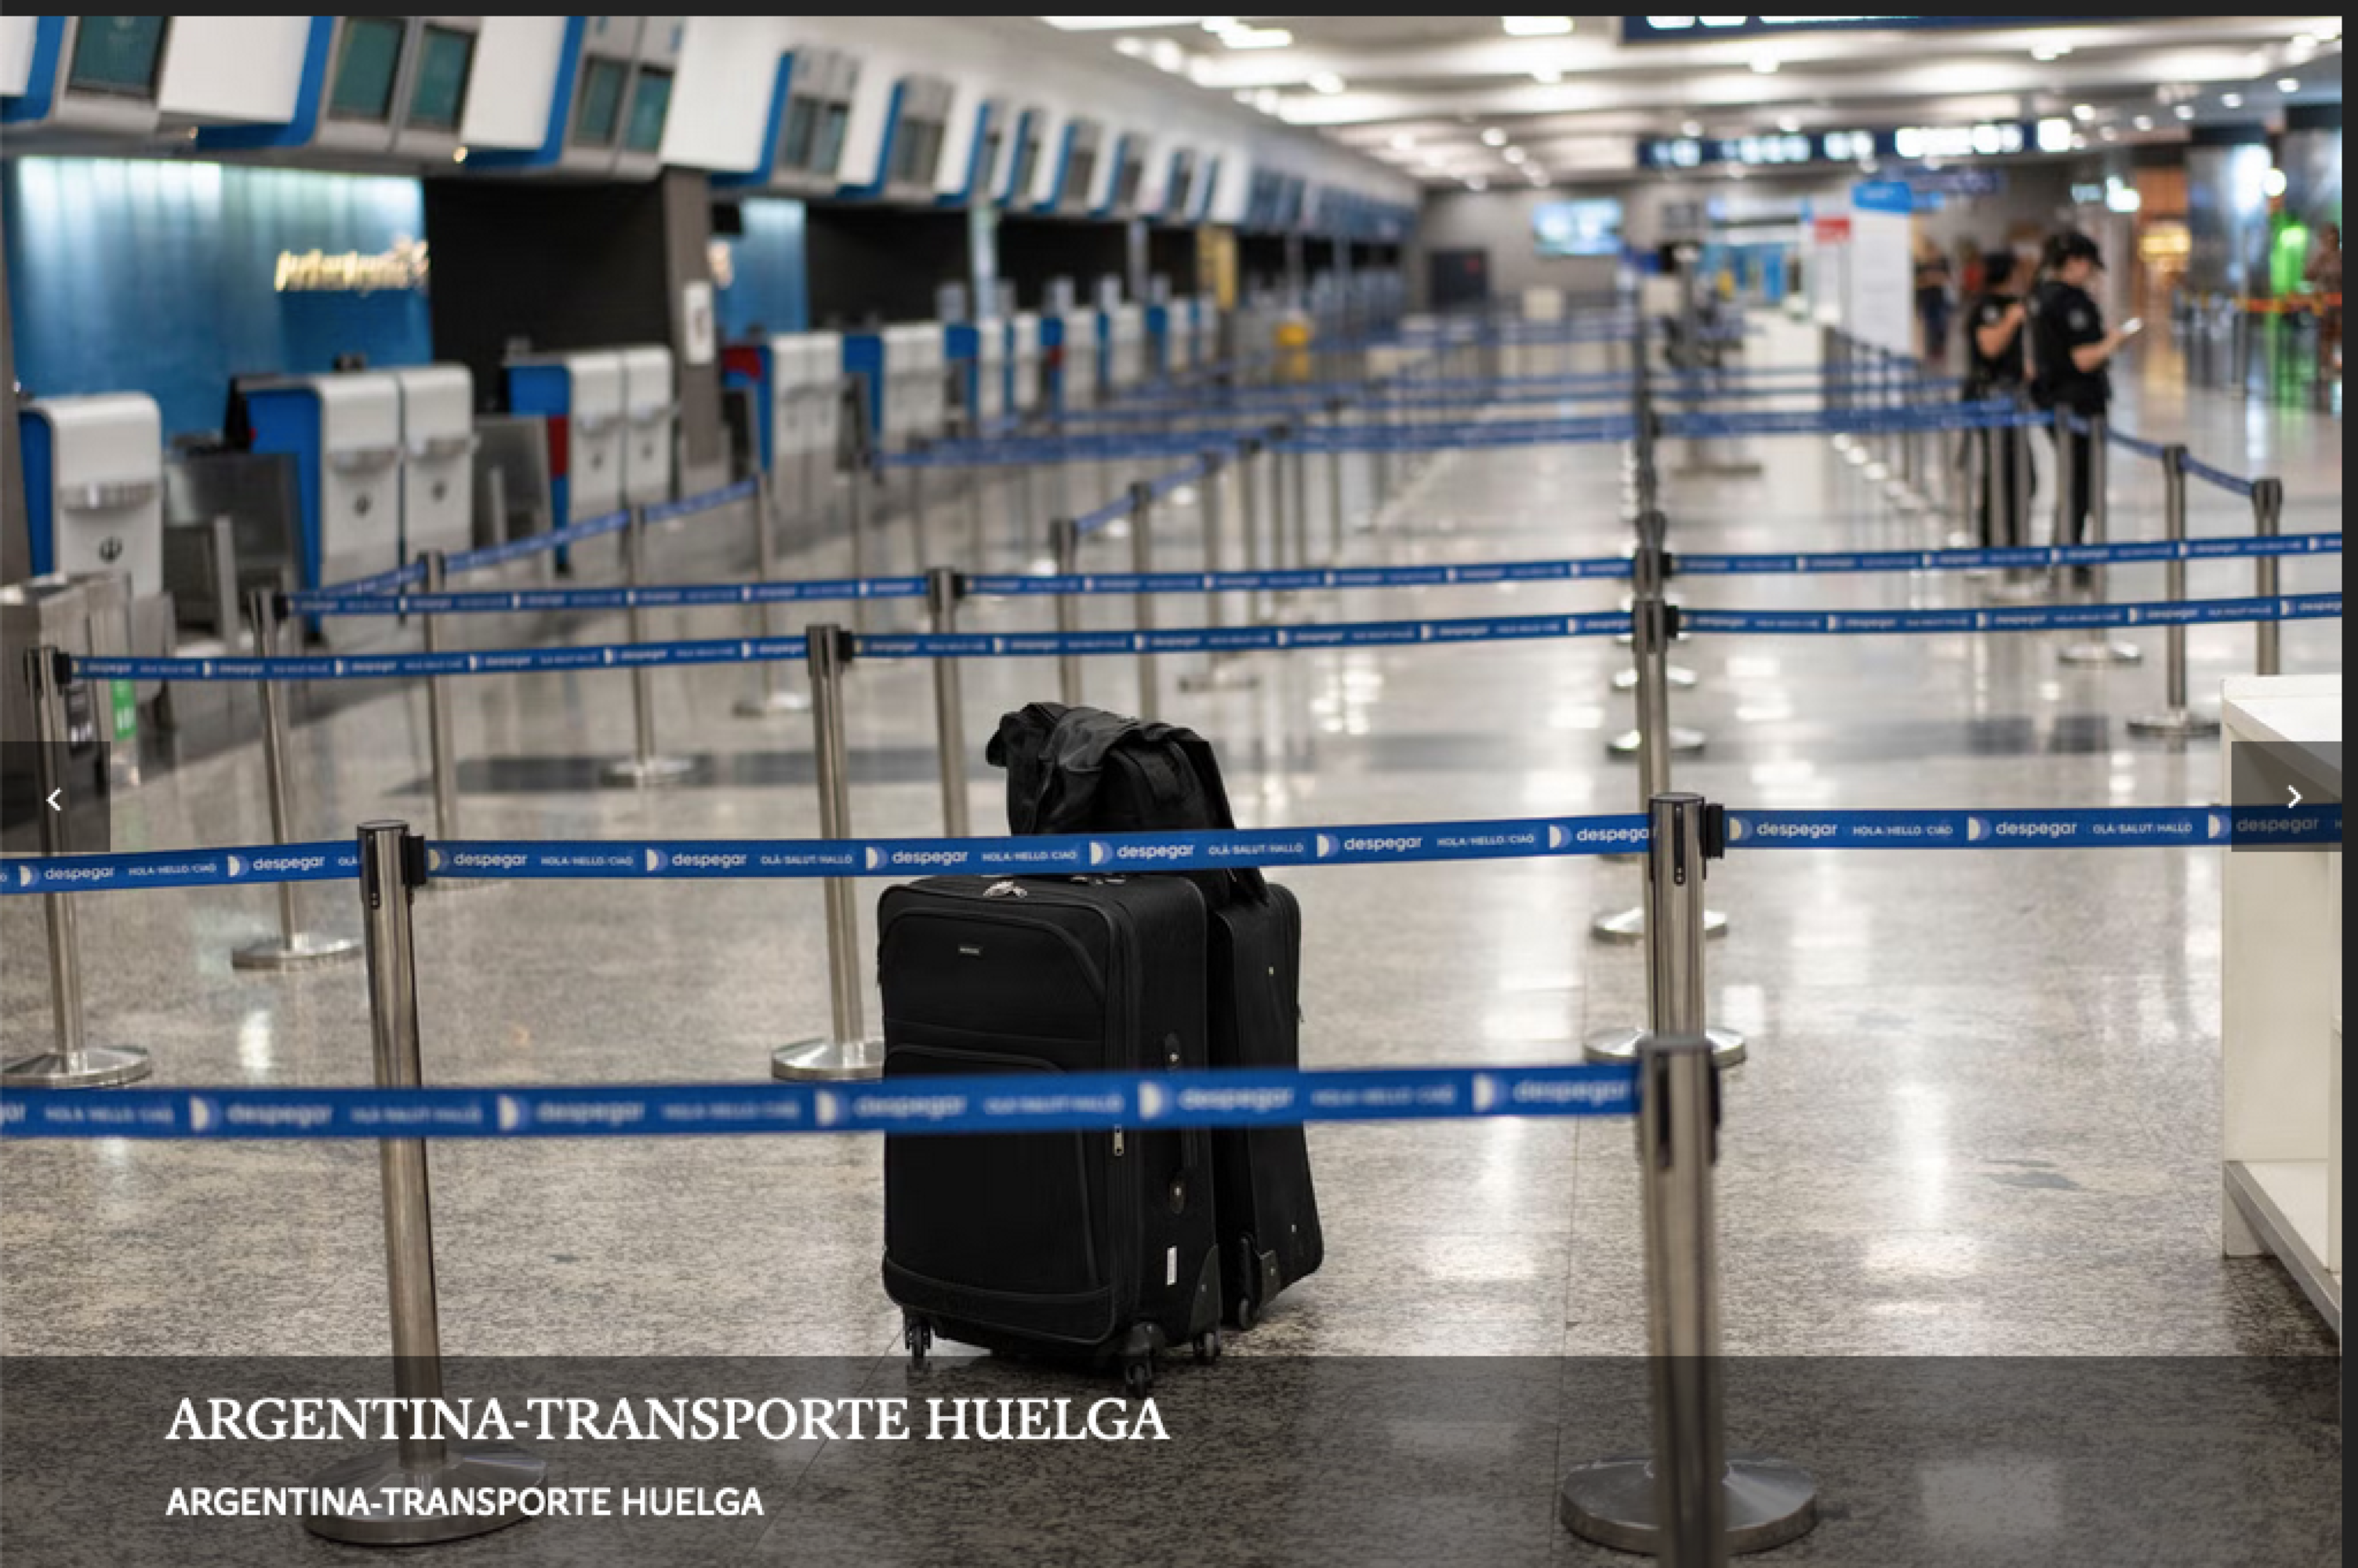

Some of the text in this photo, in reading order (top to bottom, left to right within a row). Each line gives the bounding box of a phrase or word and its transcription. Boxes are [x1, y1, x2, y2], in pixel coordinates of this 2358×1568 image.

[1756, 822, 1838, 839] despegar
[1996, 822, 2077, 839] despegar
[452, 854, 528, 869] despegar
[671, 854, 747, 869] despegar
[891, 851, 968, 866] despegar
[1116, 845, 1194, 860] despegar
[1343, 838, 1422, 852] despegar
[1576, 829, 1650, 844] despega
[43, 868, 115, 882] despegar
[253, 857, 325, 871] despegar
